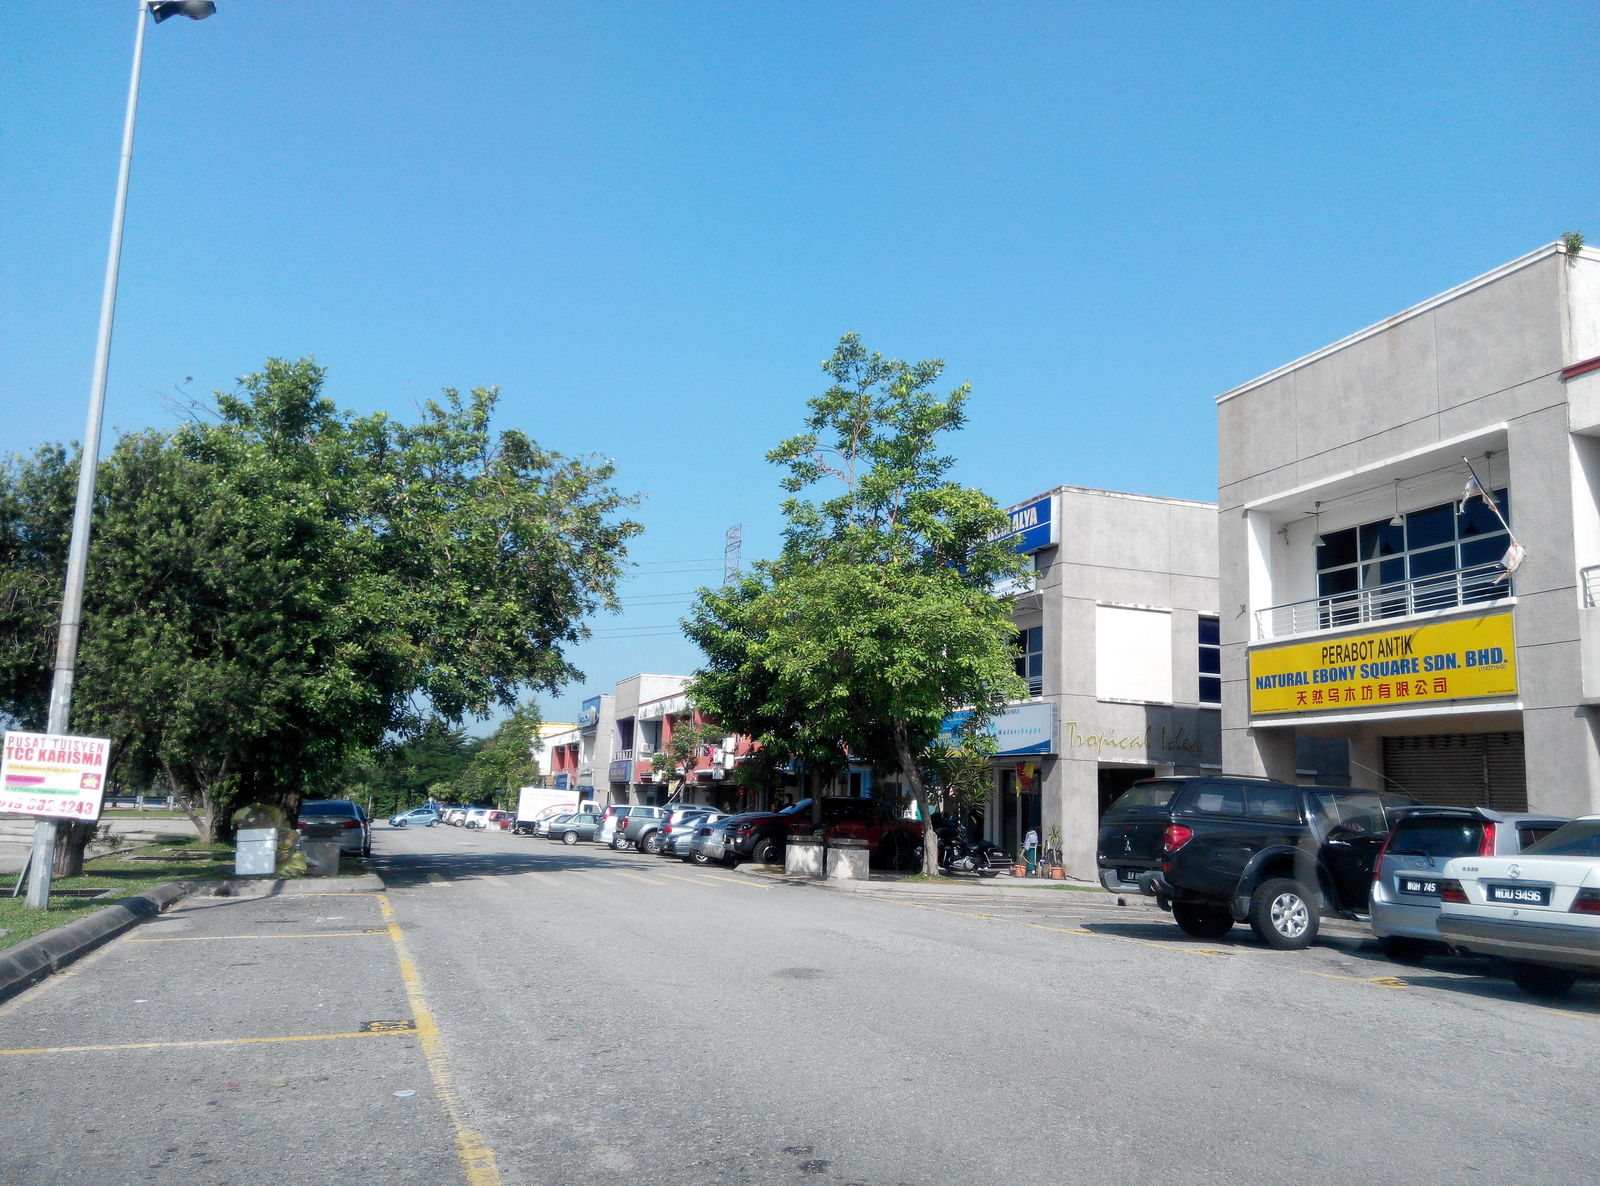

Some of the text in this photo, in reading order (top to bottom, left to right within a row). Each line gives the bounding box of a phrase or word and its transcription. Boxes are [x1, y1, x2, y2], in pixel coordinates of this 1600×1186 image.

[1012, 506, 1038, 533] ALYA
[1321, 634, 1414, 666] PERABOT ANTIK
[1255, 647, 1508, 691] NATURAL EBONY SQUARE SDN. BHD.
[1296, 677, 1448, 706] 天然乌木坊有限公司
[8, 736, 104, 753] PUSAT TUISYEN
[1065, 721, 1202, 755] Tropical Idea
[6, 747, 103, 766] TCC KARISMA
[58, 800, 94, 815] 4243
[1423, 882, 1437, 892] 745
[1495, 888, 1541, 902] WDU 9496
